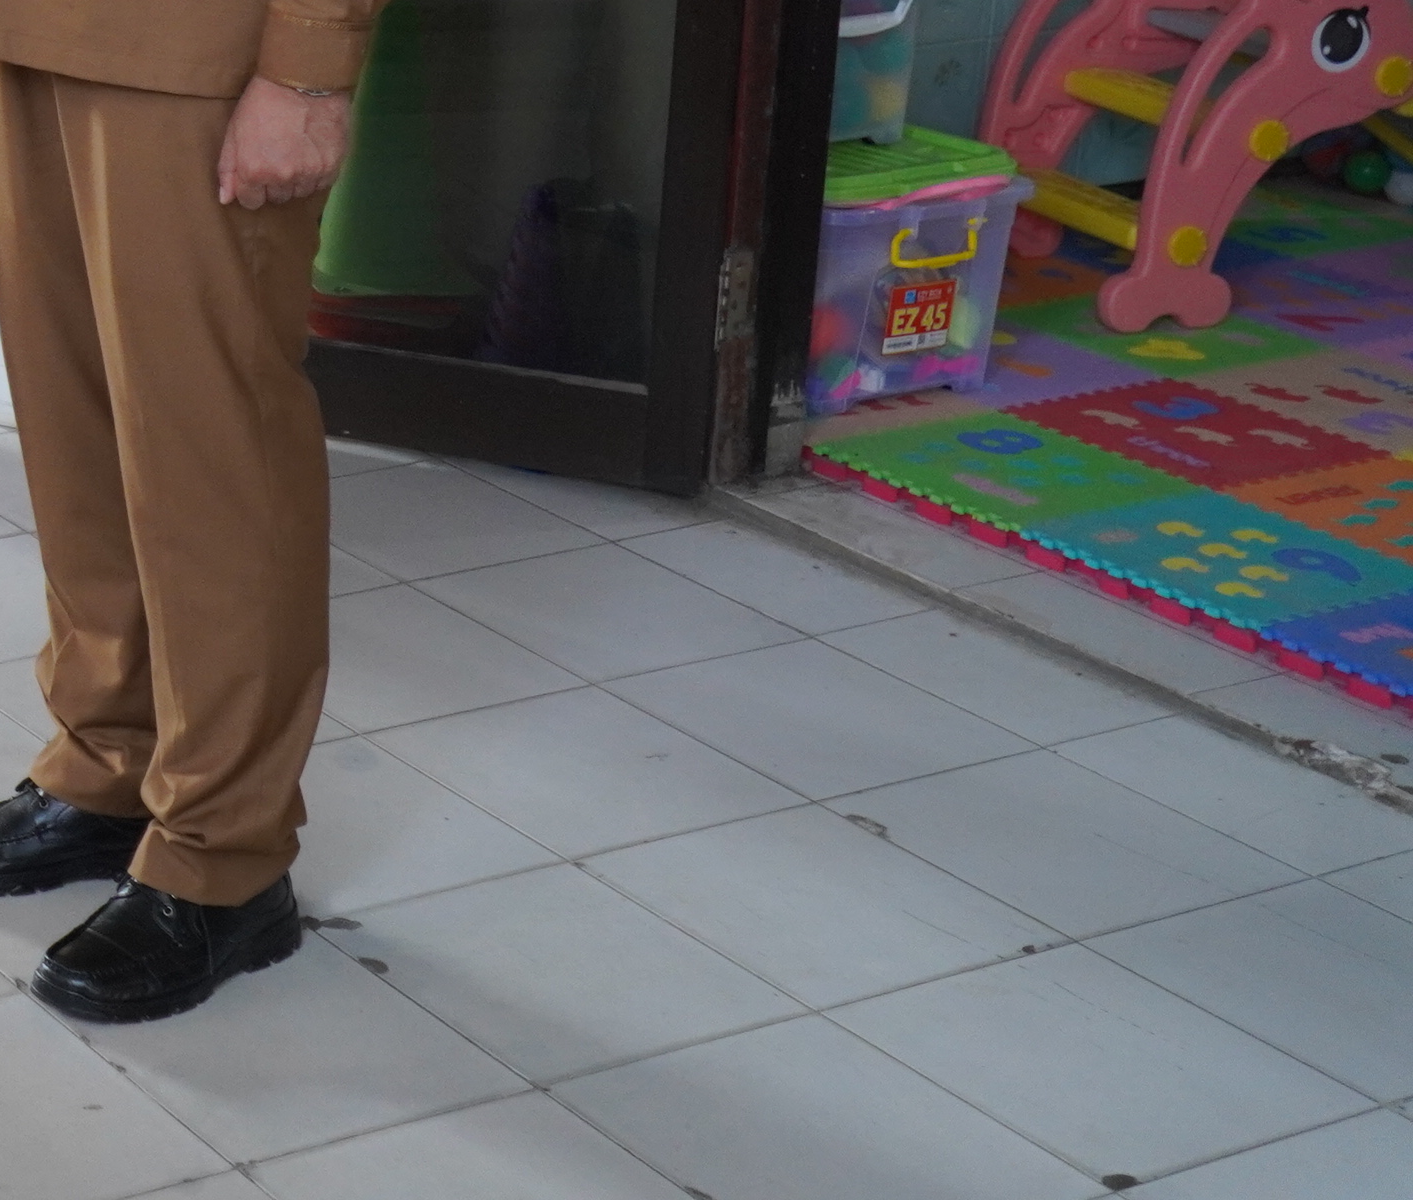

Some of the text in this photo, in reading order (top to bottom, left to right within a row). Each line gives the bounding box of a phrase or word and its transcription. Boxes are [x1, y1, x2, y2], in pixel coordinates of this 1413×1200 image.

[891, 301, 948, 337] EZ 45
[957, 429, 1044, 455] 8
